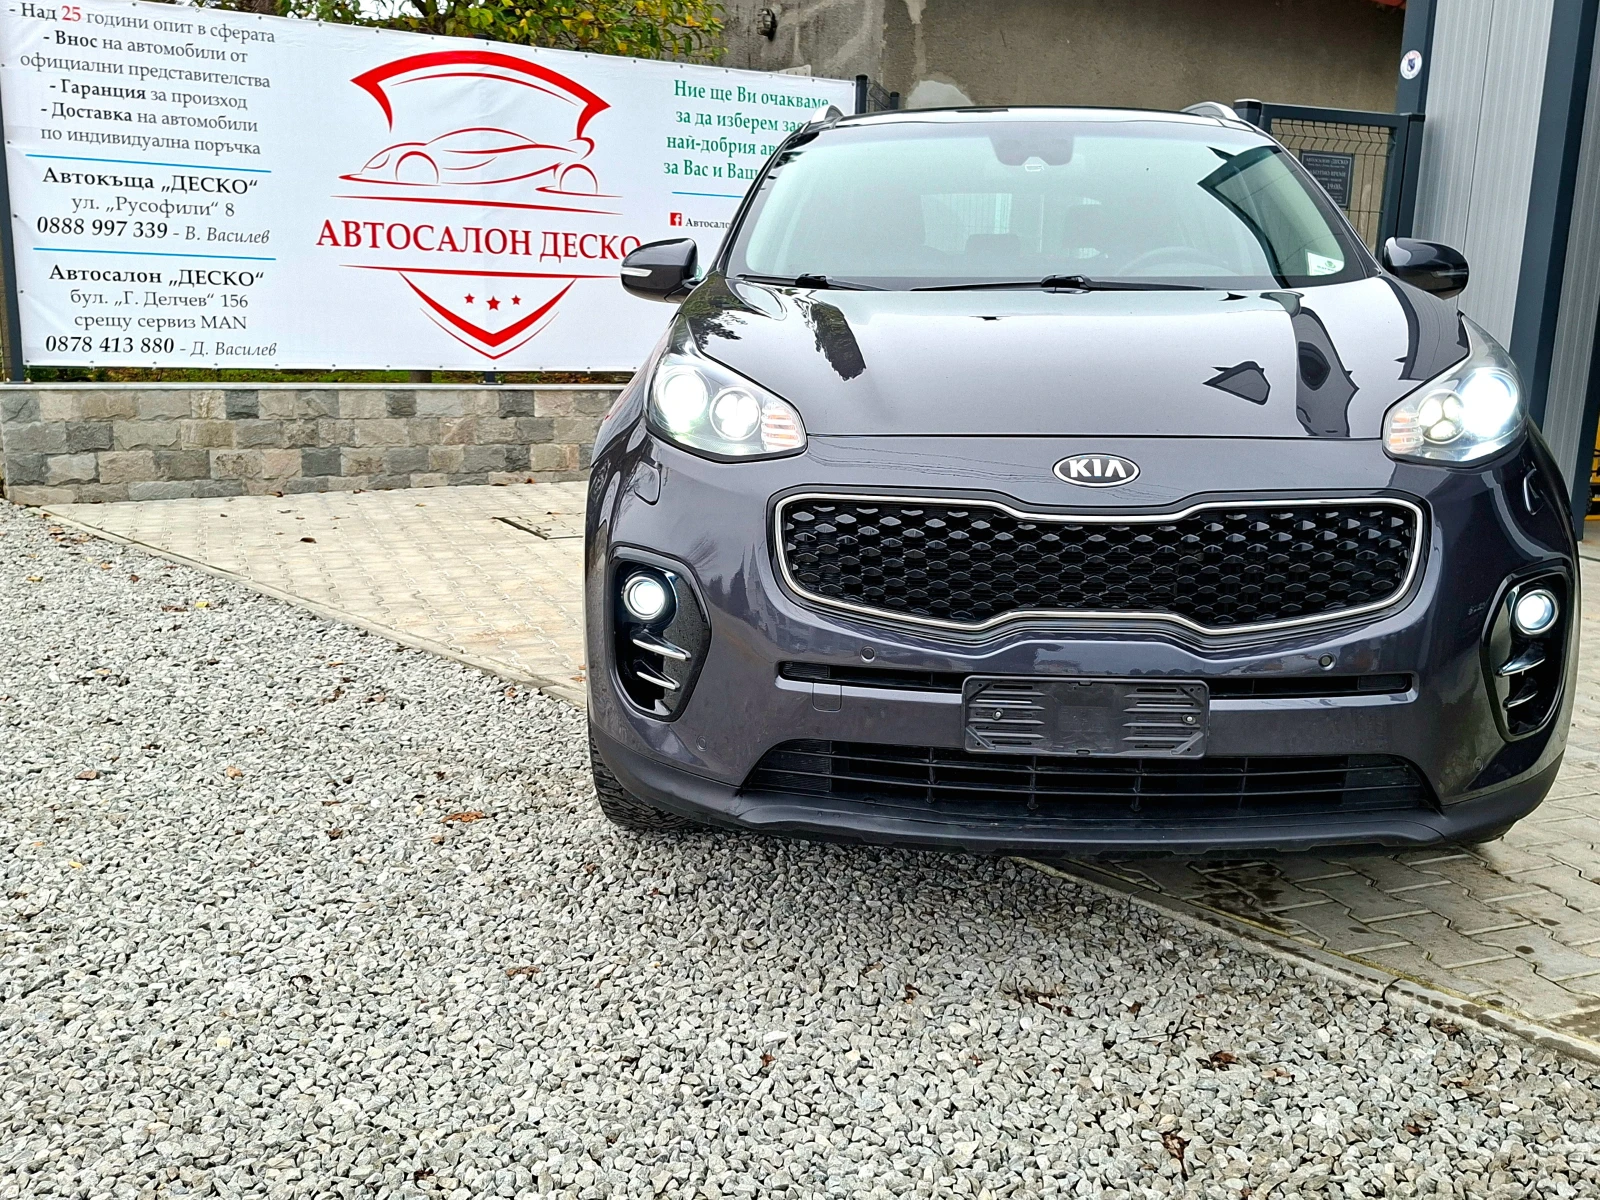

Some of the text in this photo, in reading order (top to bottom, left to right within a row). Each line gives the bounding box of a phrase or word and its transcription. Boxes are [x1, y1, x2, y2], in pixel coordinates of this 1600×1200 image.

[20, 2, 57, 22] Над
[62, 5, 81, 22] 25
[87, 14, 149, 29] години
[153, 21, 193, 33] опит
[198, 25, 206, 35] в
[210, 24, 275, 44] сферата
[54, 30, 97, 48] Внос
[102, 39, 123, 50] на
[127, 42, 227, 60] автомобили
[230, 52, 248, 62] от
[20, 52, 270, 88] официални представителства
[60, 78, 146, 100] Гаранция
[151, 91, 167, 101] за
[172, 93, 248, 111] произход
[674, 80, 705, 98] Ние
[710, 88, 732, 102] ще
[737, 86, 756, 103] Ви
[52, 102, 133, 122] Доставка
[137, 113, 157, 124] на
[162, 115, 258, 132] автомобили
[676, 111, 691, 123] за
[695, 113, 712, 127] да
[717, 112, 778, 134] изберем
[41, 129, 261, 156] по индивидуална поръчка
[667, 135, 756, 158] най-добрия
[42, 167, 155, 190] Автокъща
[664, 159, 758, 180] за Вас и Ваш
[71, 198, 99, 213] ул.
[225, 203, 234, 217] 8
[37, 216, 84, 235] 0888
[92, 219, 128, 236] 997
[133, 221, 167, 238] 339
[185, 226, 200, 240] В.
[207, 227, 270, 243] Василев
[685, 217, 731, 229] Автосало
[316, 219, 641, 262] АВТОСАЛОН ДЕСКО
[49, 264, 162, 283] Автосалон
[71, 289, 108, 308] бул.
[221, 294, 248, 308] 156
[75, 315, 246, 332] срещу сервиз MAN
[46, 336, 92, 352] 0878
[99, 337, 133, 353] 413
[141, 337, 174, 353] 880
[190, 341, 208, 357] Д.
[215, 342, 277, 356] Василев
[1068, 458, 1127, 478] KIA
